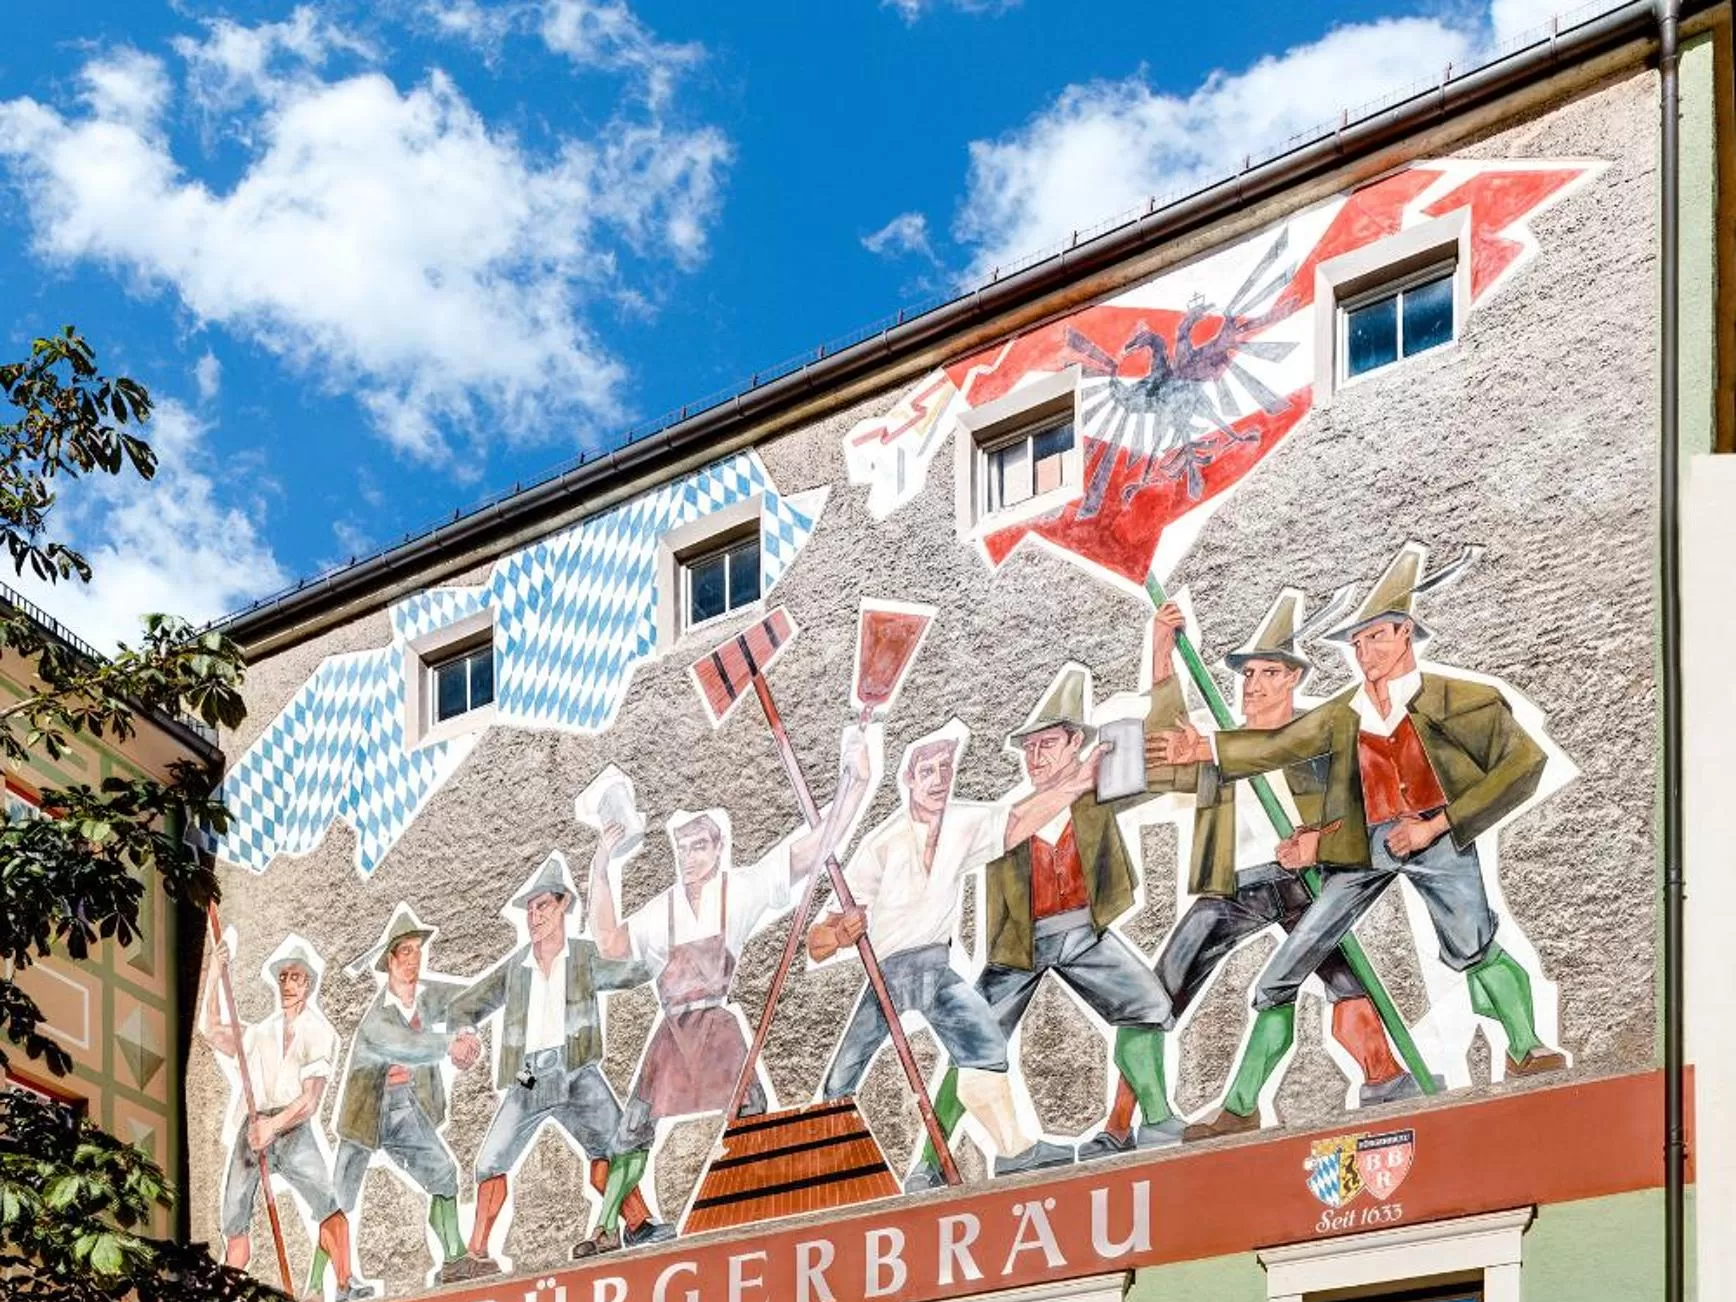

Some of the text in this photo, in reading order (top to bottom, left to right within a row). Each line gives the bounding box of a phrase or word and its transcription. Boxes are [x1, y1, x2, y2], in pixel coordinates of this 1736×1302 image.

[1387, 1151, 1402, 1168] B
[1315, 1204, 1403, 1233] Seit 1633
